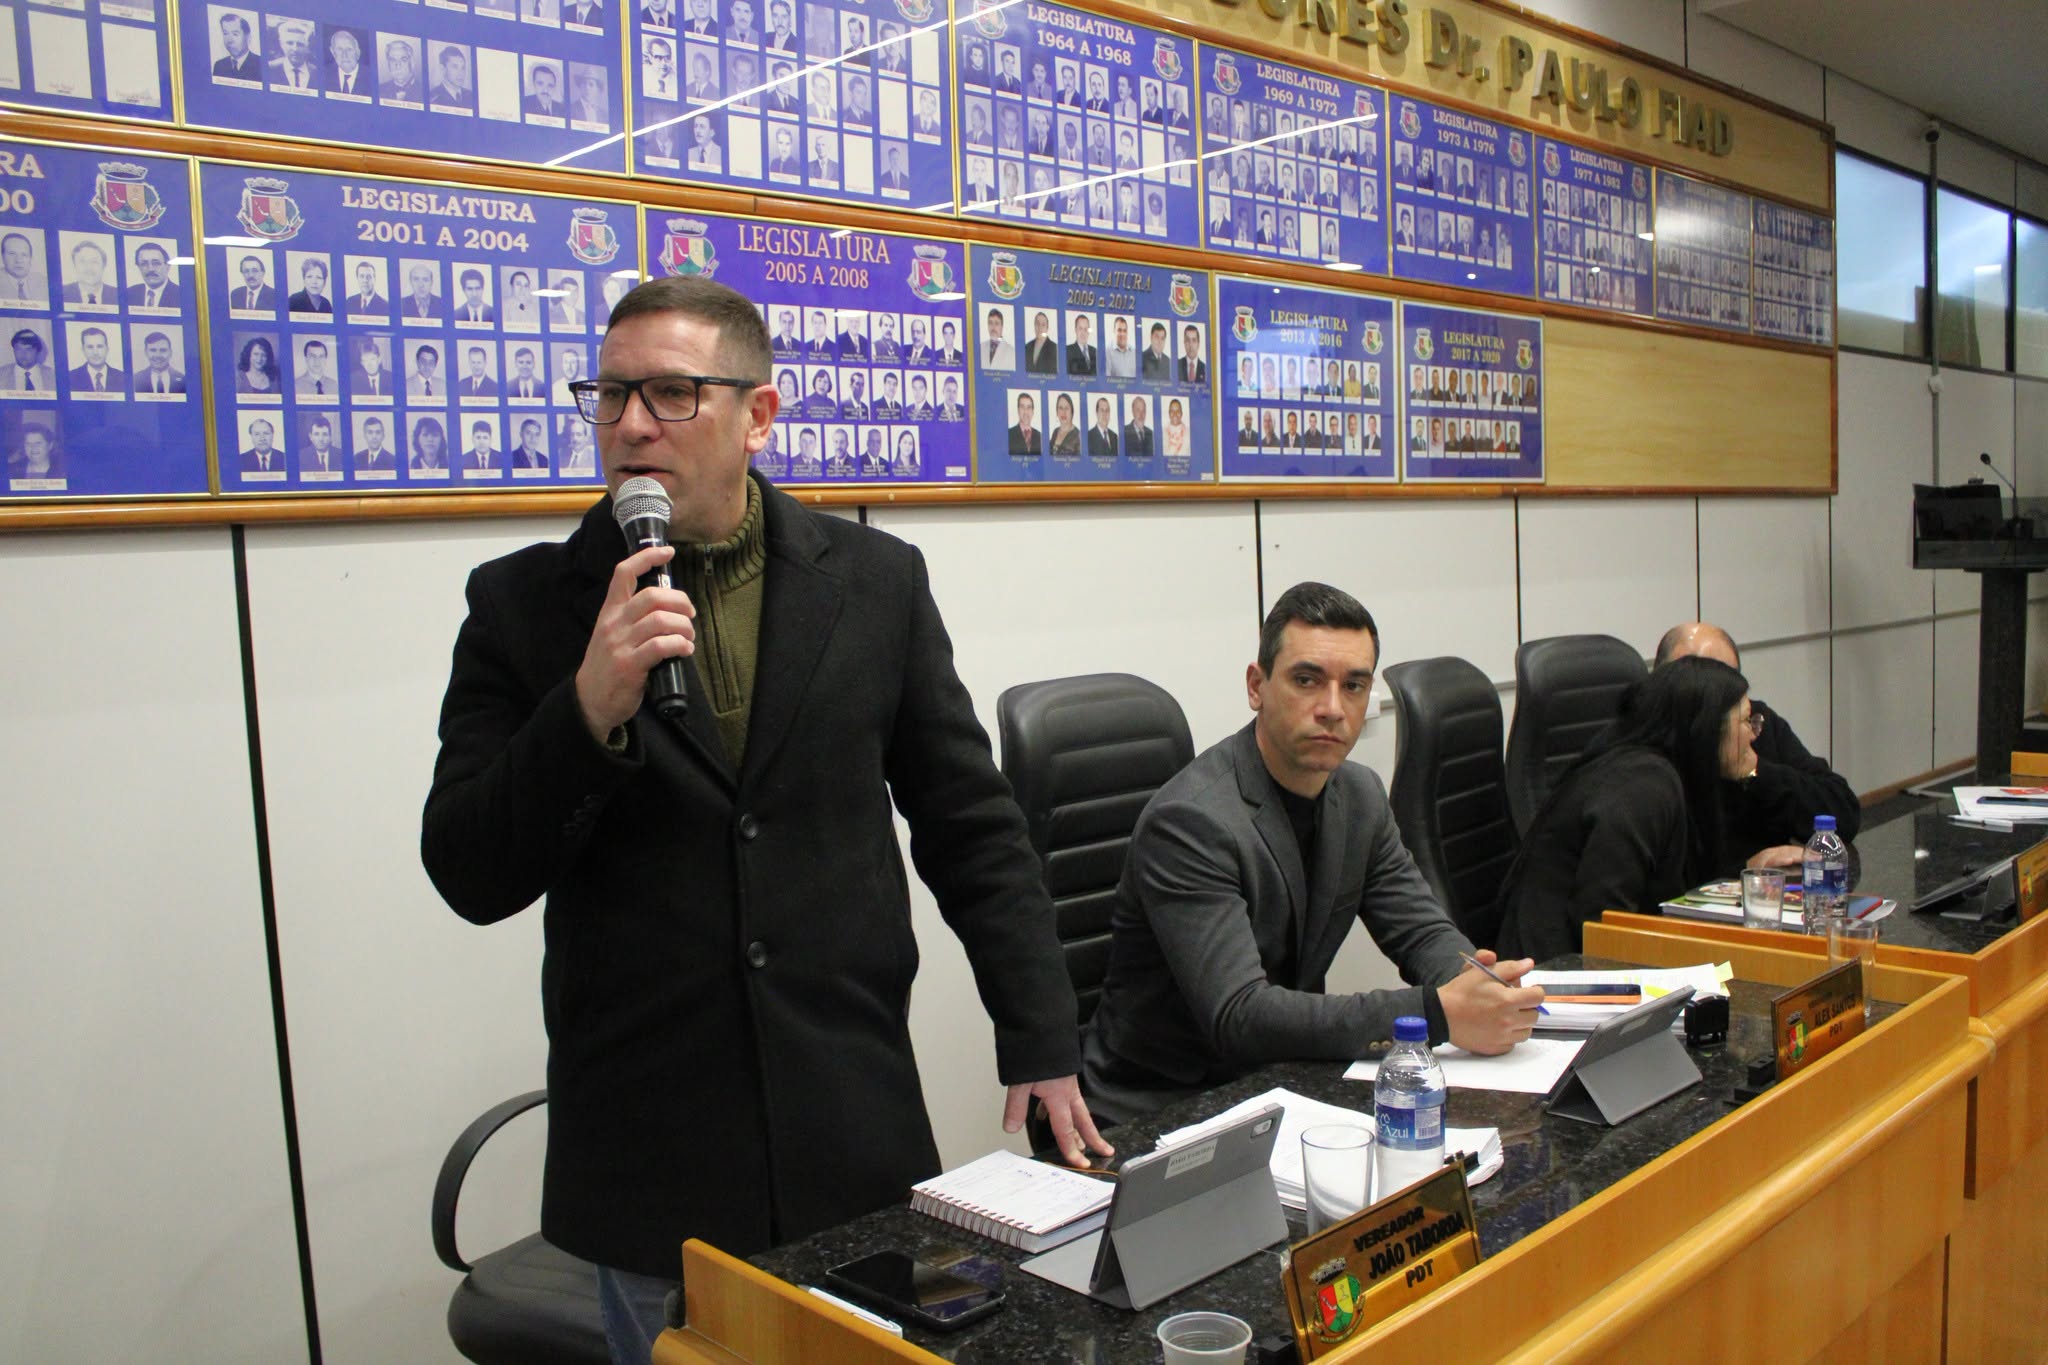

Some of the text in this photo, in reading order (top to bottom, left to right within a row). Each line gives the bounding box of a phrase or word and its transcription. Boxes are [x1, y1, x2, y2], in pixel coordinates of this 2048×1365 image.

[1027, 3, 1136, 45] LEGISLATURA
[1038, 30, 1132, 66] 1964 A 1968
[1210, 0, 1735, 157] RES Dr. PAULO FIAD
[1256, 63, 1341, 97] LEGISLATURA
[1264, 86, 1338, 116] 1969 A 1972
[1433, 110, 1498, 139] LEGISLATURA
[1438, 130, 1495, 156] 1973 A 1976
[1570, 149, 1624, 175] LEGISLATURA
[1574, 167, 1592, 182] 1977
[1595, 174, 1600, 185] A
[342, 186, 536, 223] LEGISLATURA
[357, 220, 529, 252] 2001 A 2004
[737, 224, 891, 264] LEGISLATURA
[765, 261, 869, 288] 2005 A 2008
[1049, 263, 1152, 291] LEGISLATURA
[1067, 289, 1095, 307] 2009
[1109, 294, 1136, 311] 2012
[1270, 310, 1348, 332] LEGISLATURA
[1308, 333, 1316, 345] A
[1319, 333, 1342, 348] 2016
[1444, 331, 1505, 350] LEGISLATURA
[1473, 350, 1480, 362] A
[1383, 1125, 1408, 1138] Azul
[1353, 1206, 1425, 1252] VEREADOR
[1369, 1211, 1466, 1279] JOÃO TABORDA
[1405, 1259, 1434, 1288] PDT
